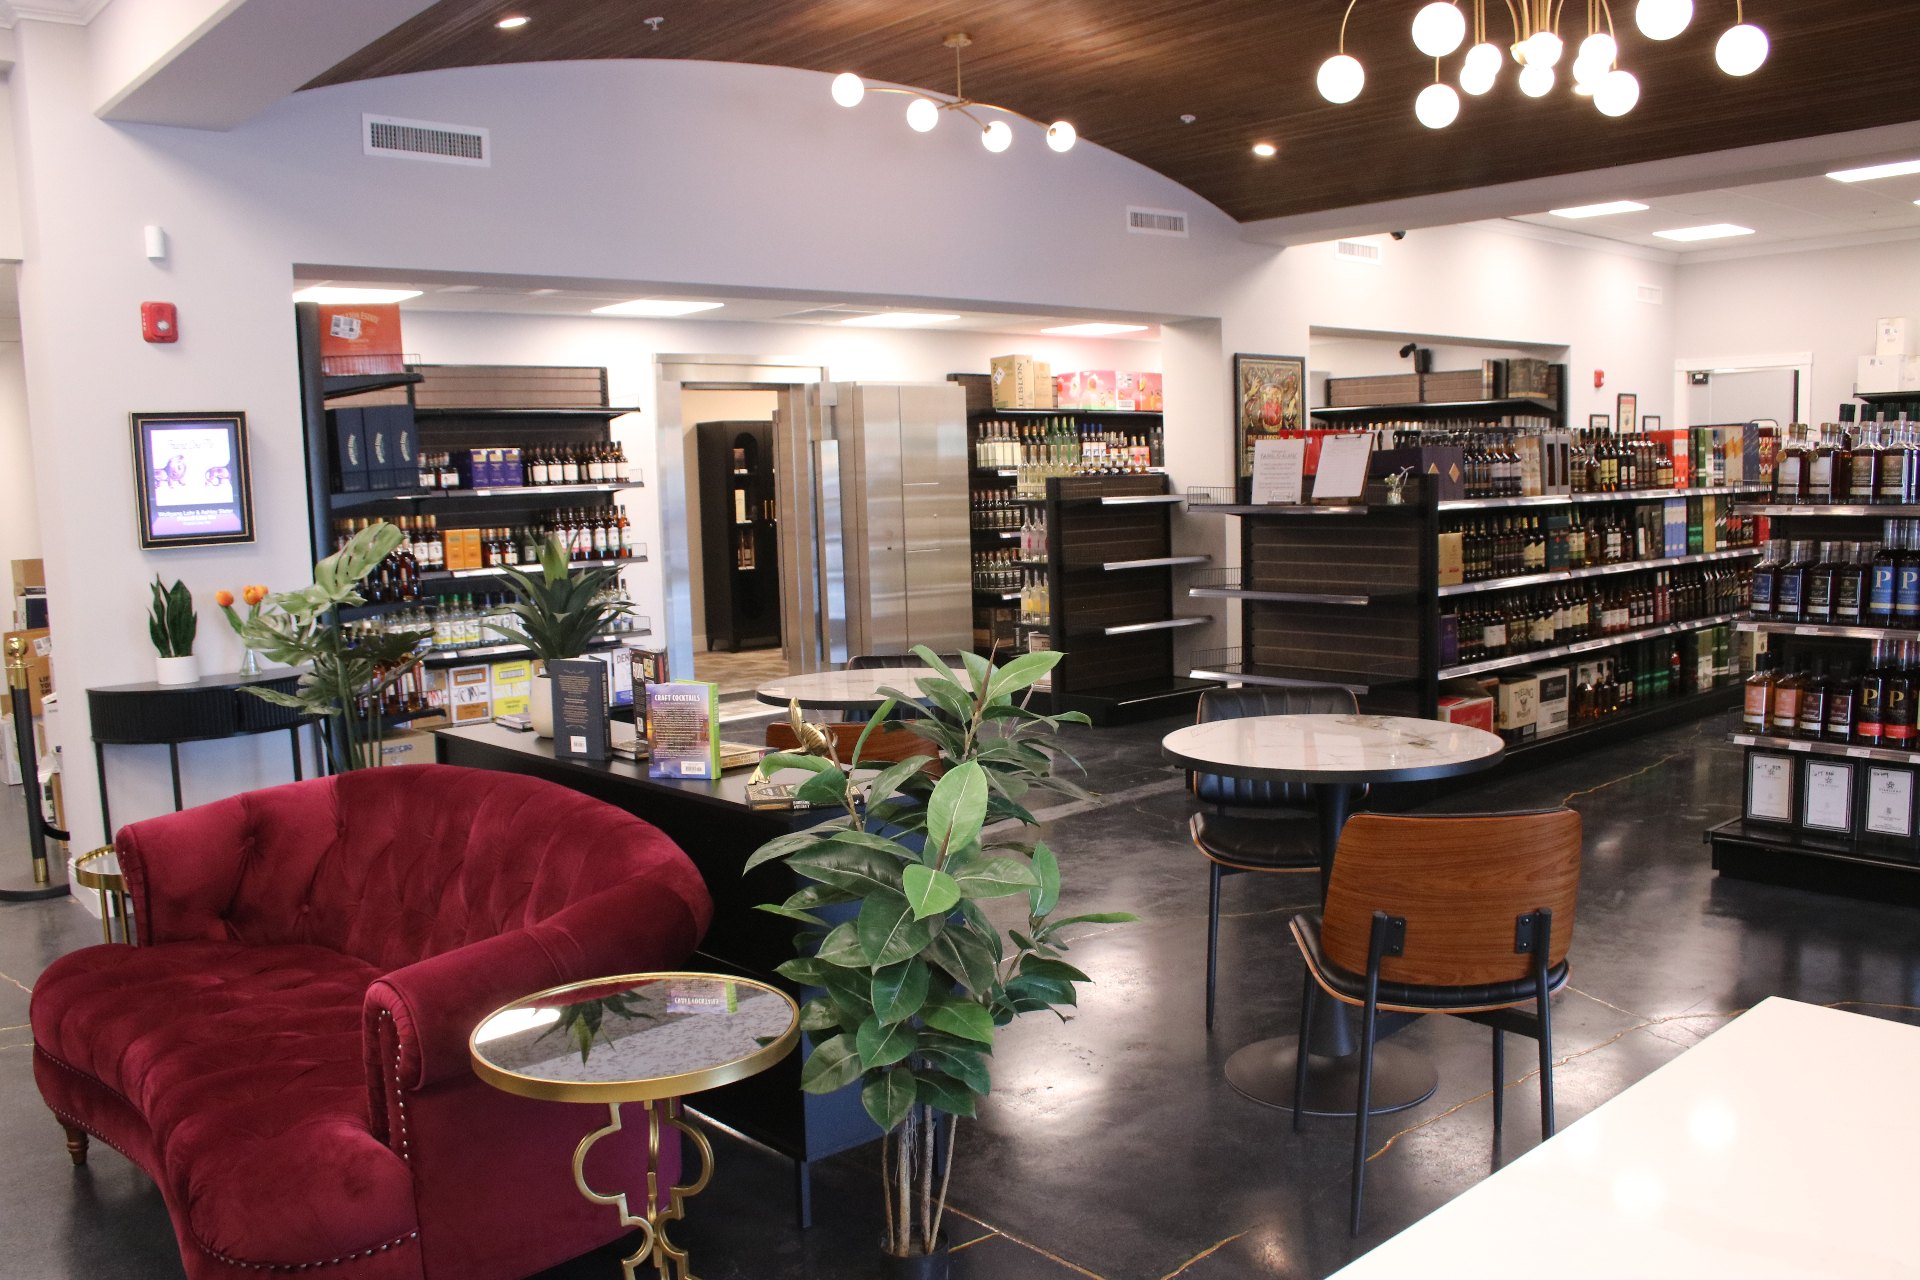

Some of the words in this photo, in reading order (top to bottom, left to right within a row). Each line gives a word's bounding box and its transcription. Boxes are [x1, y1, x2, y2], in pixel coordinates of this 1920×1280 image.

[1016, 362, 1024, 407] LEBLON
[1875, 570, 1891, 588] P
[1902, 571, 1918, 589] P
[672, 694, 701, 702] COCKTAILS
[1862, 687, 1878, 706] P
[1889, 690, 1904, 708] P
